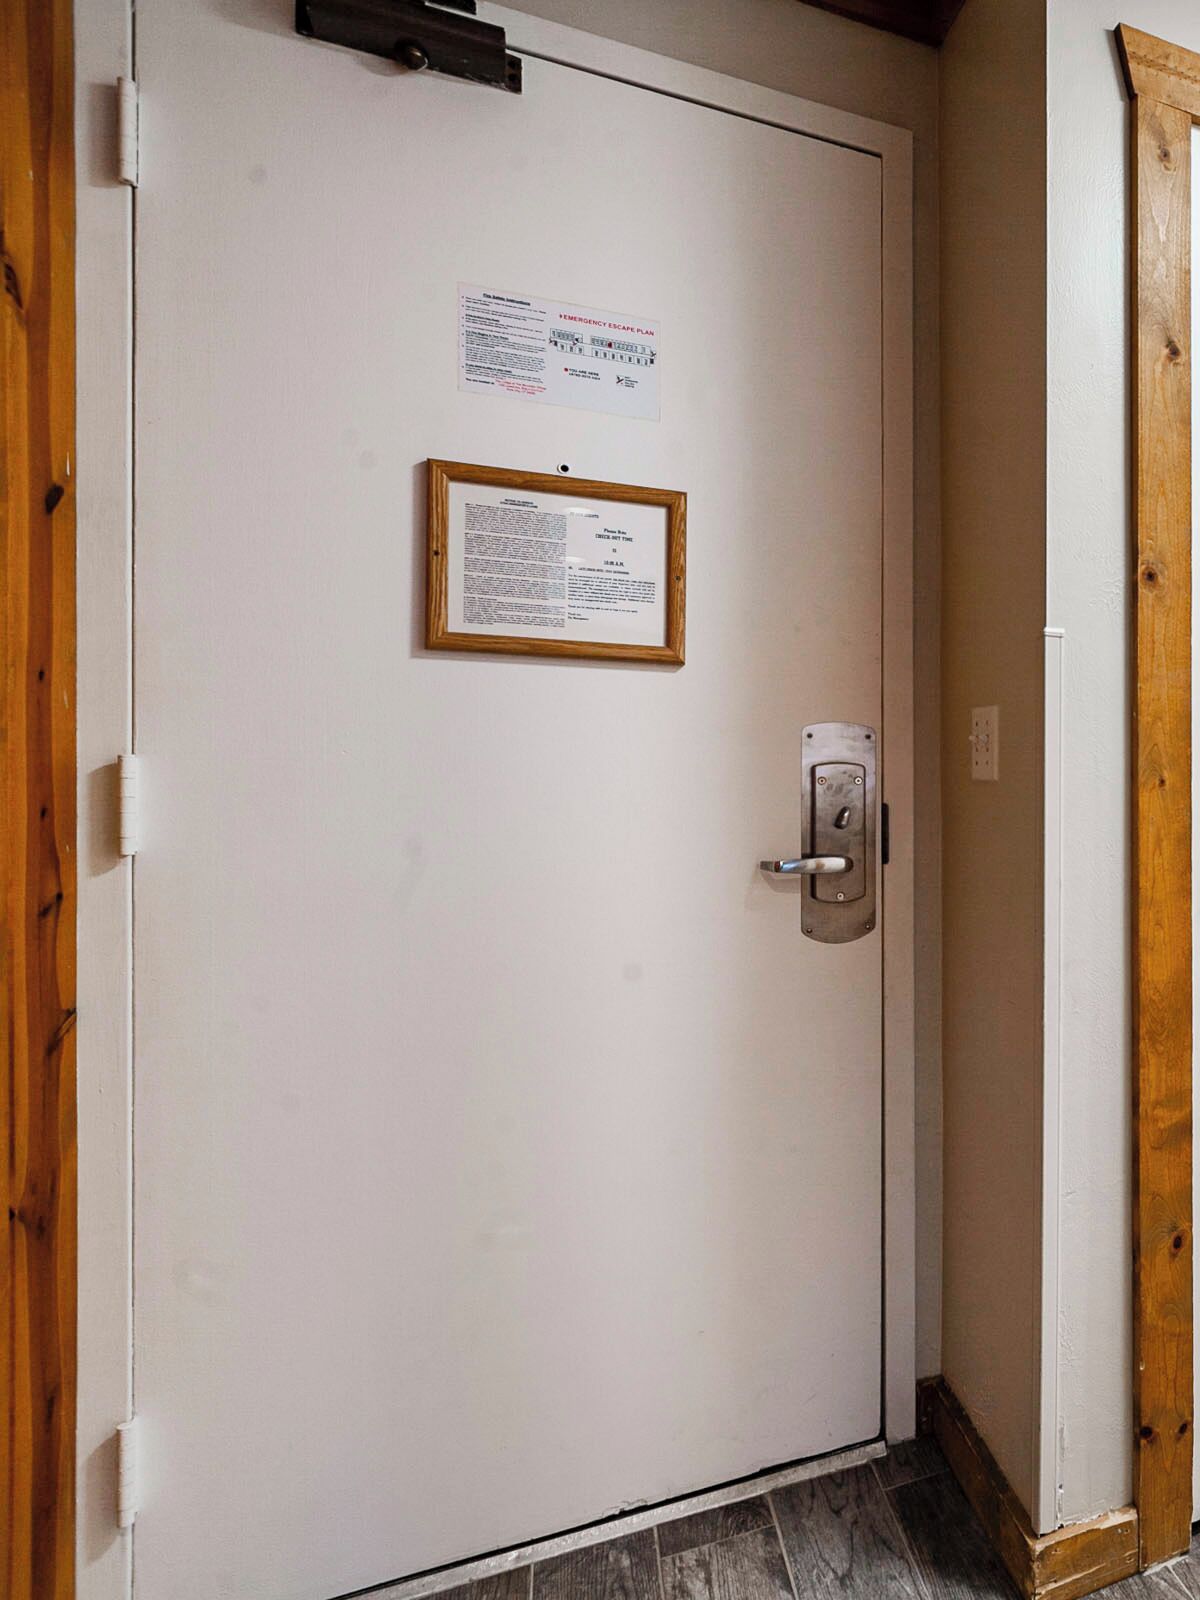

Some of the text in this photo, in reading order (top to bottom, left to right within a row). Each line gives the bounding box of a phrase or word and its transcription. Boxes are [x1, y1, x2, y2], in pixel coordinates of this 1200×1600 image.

[563, 314, 655, 337] EMERGENCY ESCAPE PLAN
